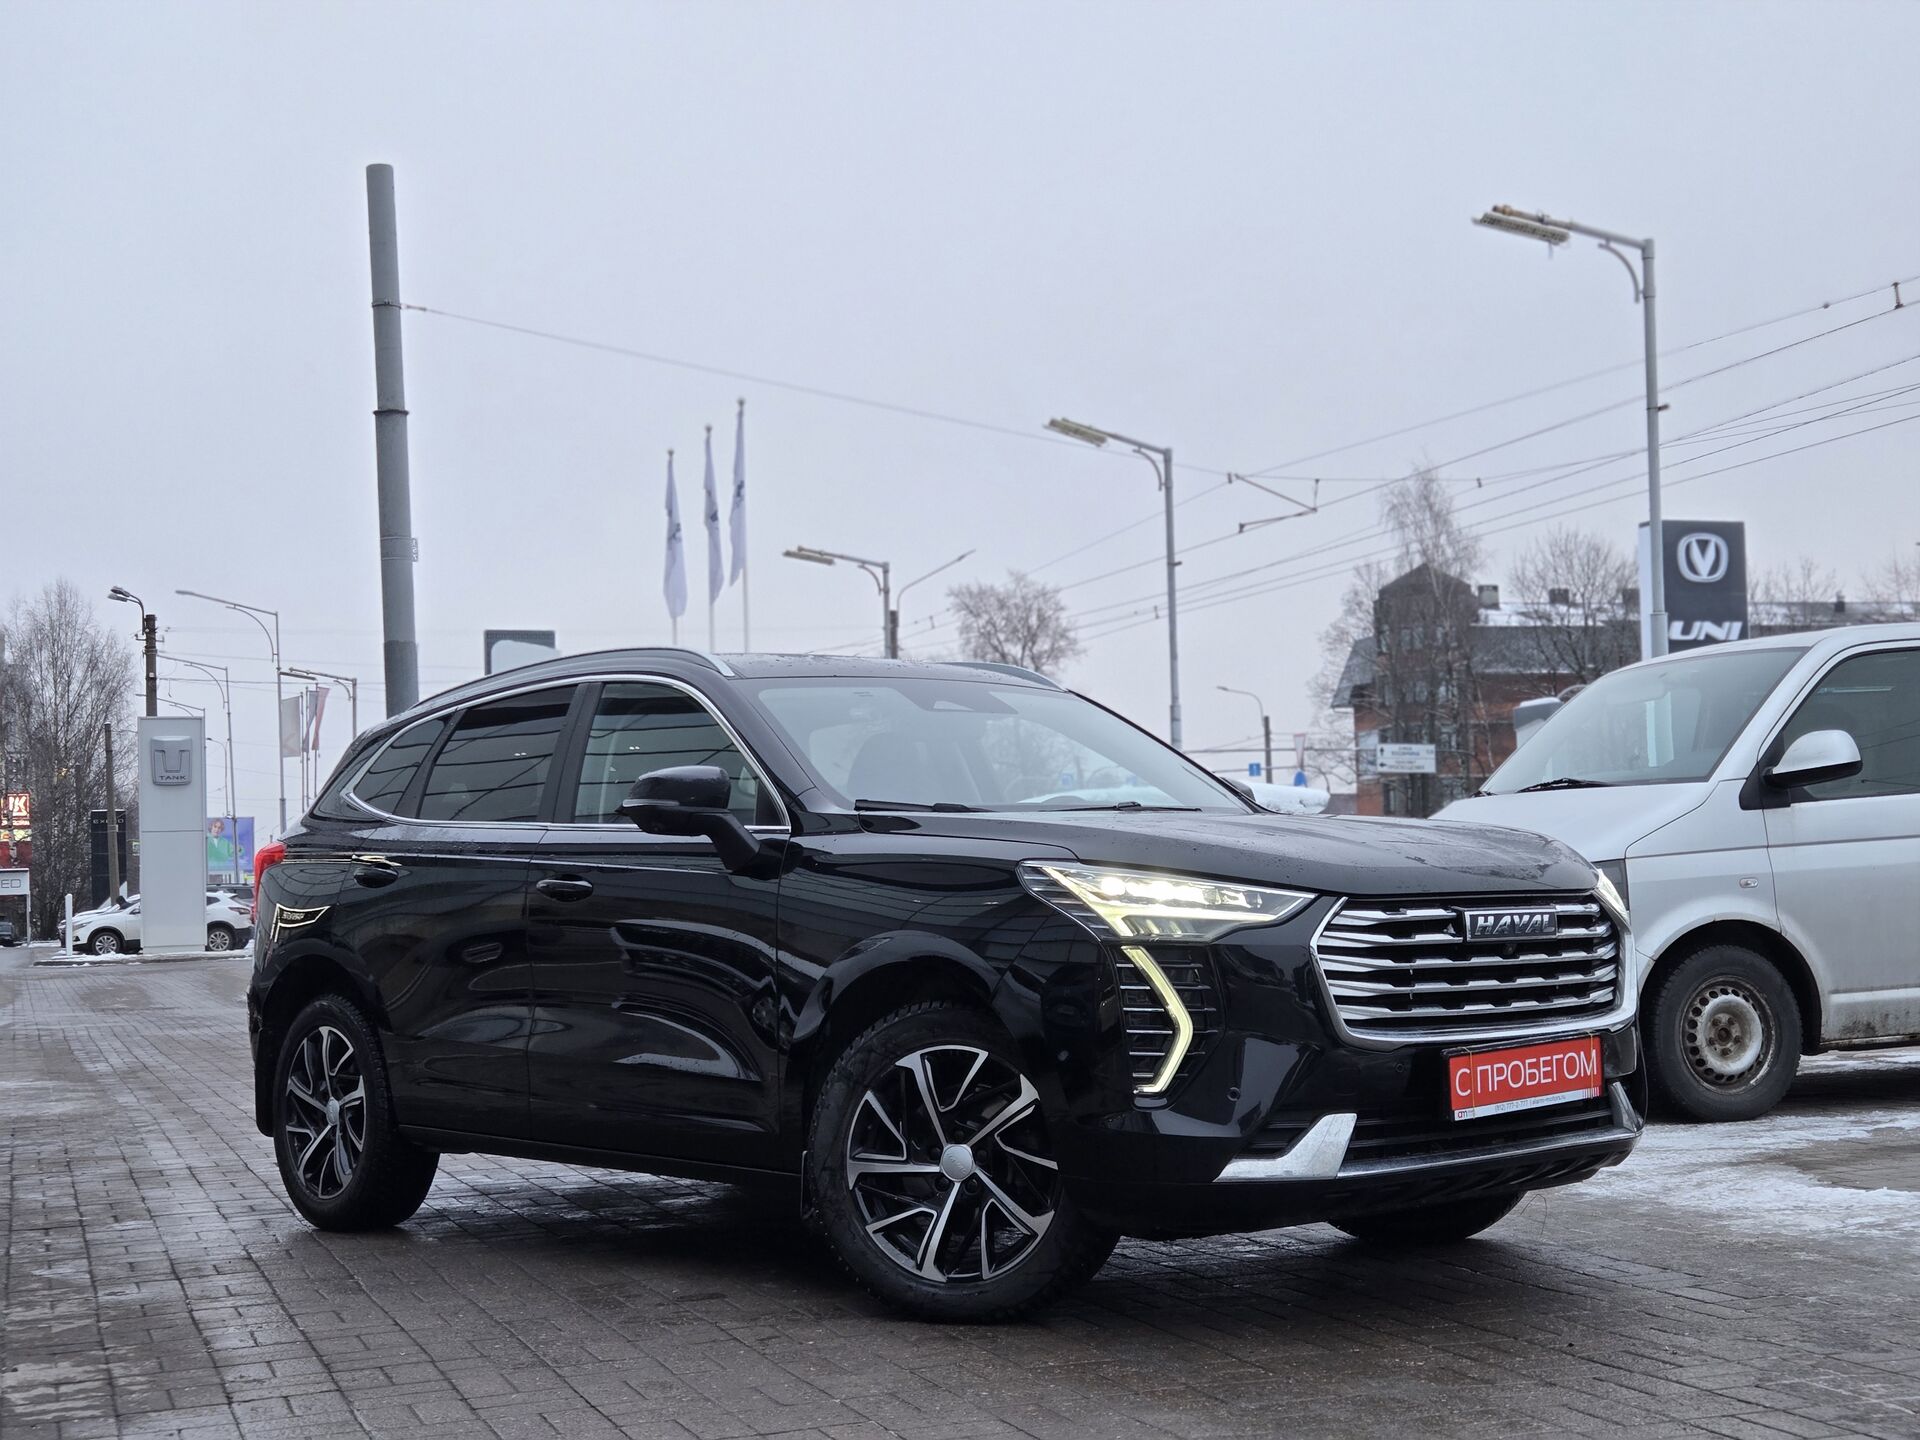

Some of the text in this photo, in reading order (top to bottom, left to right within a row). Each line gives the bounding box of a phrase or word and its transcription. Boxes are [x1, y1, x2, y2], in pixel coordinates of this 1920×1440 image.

[1668, 620, 1743, 641] UNI
[1474, 914, 1555, 935] HAVAL
[1455, 1049, 1597, 1097] С ПРОБЕГОМ
